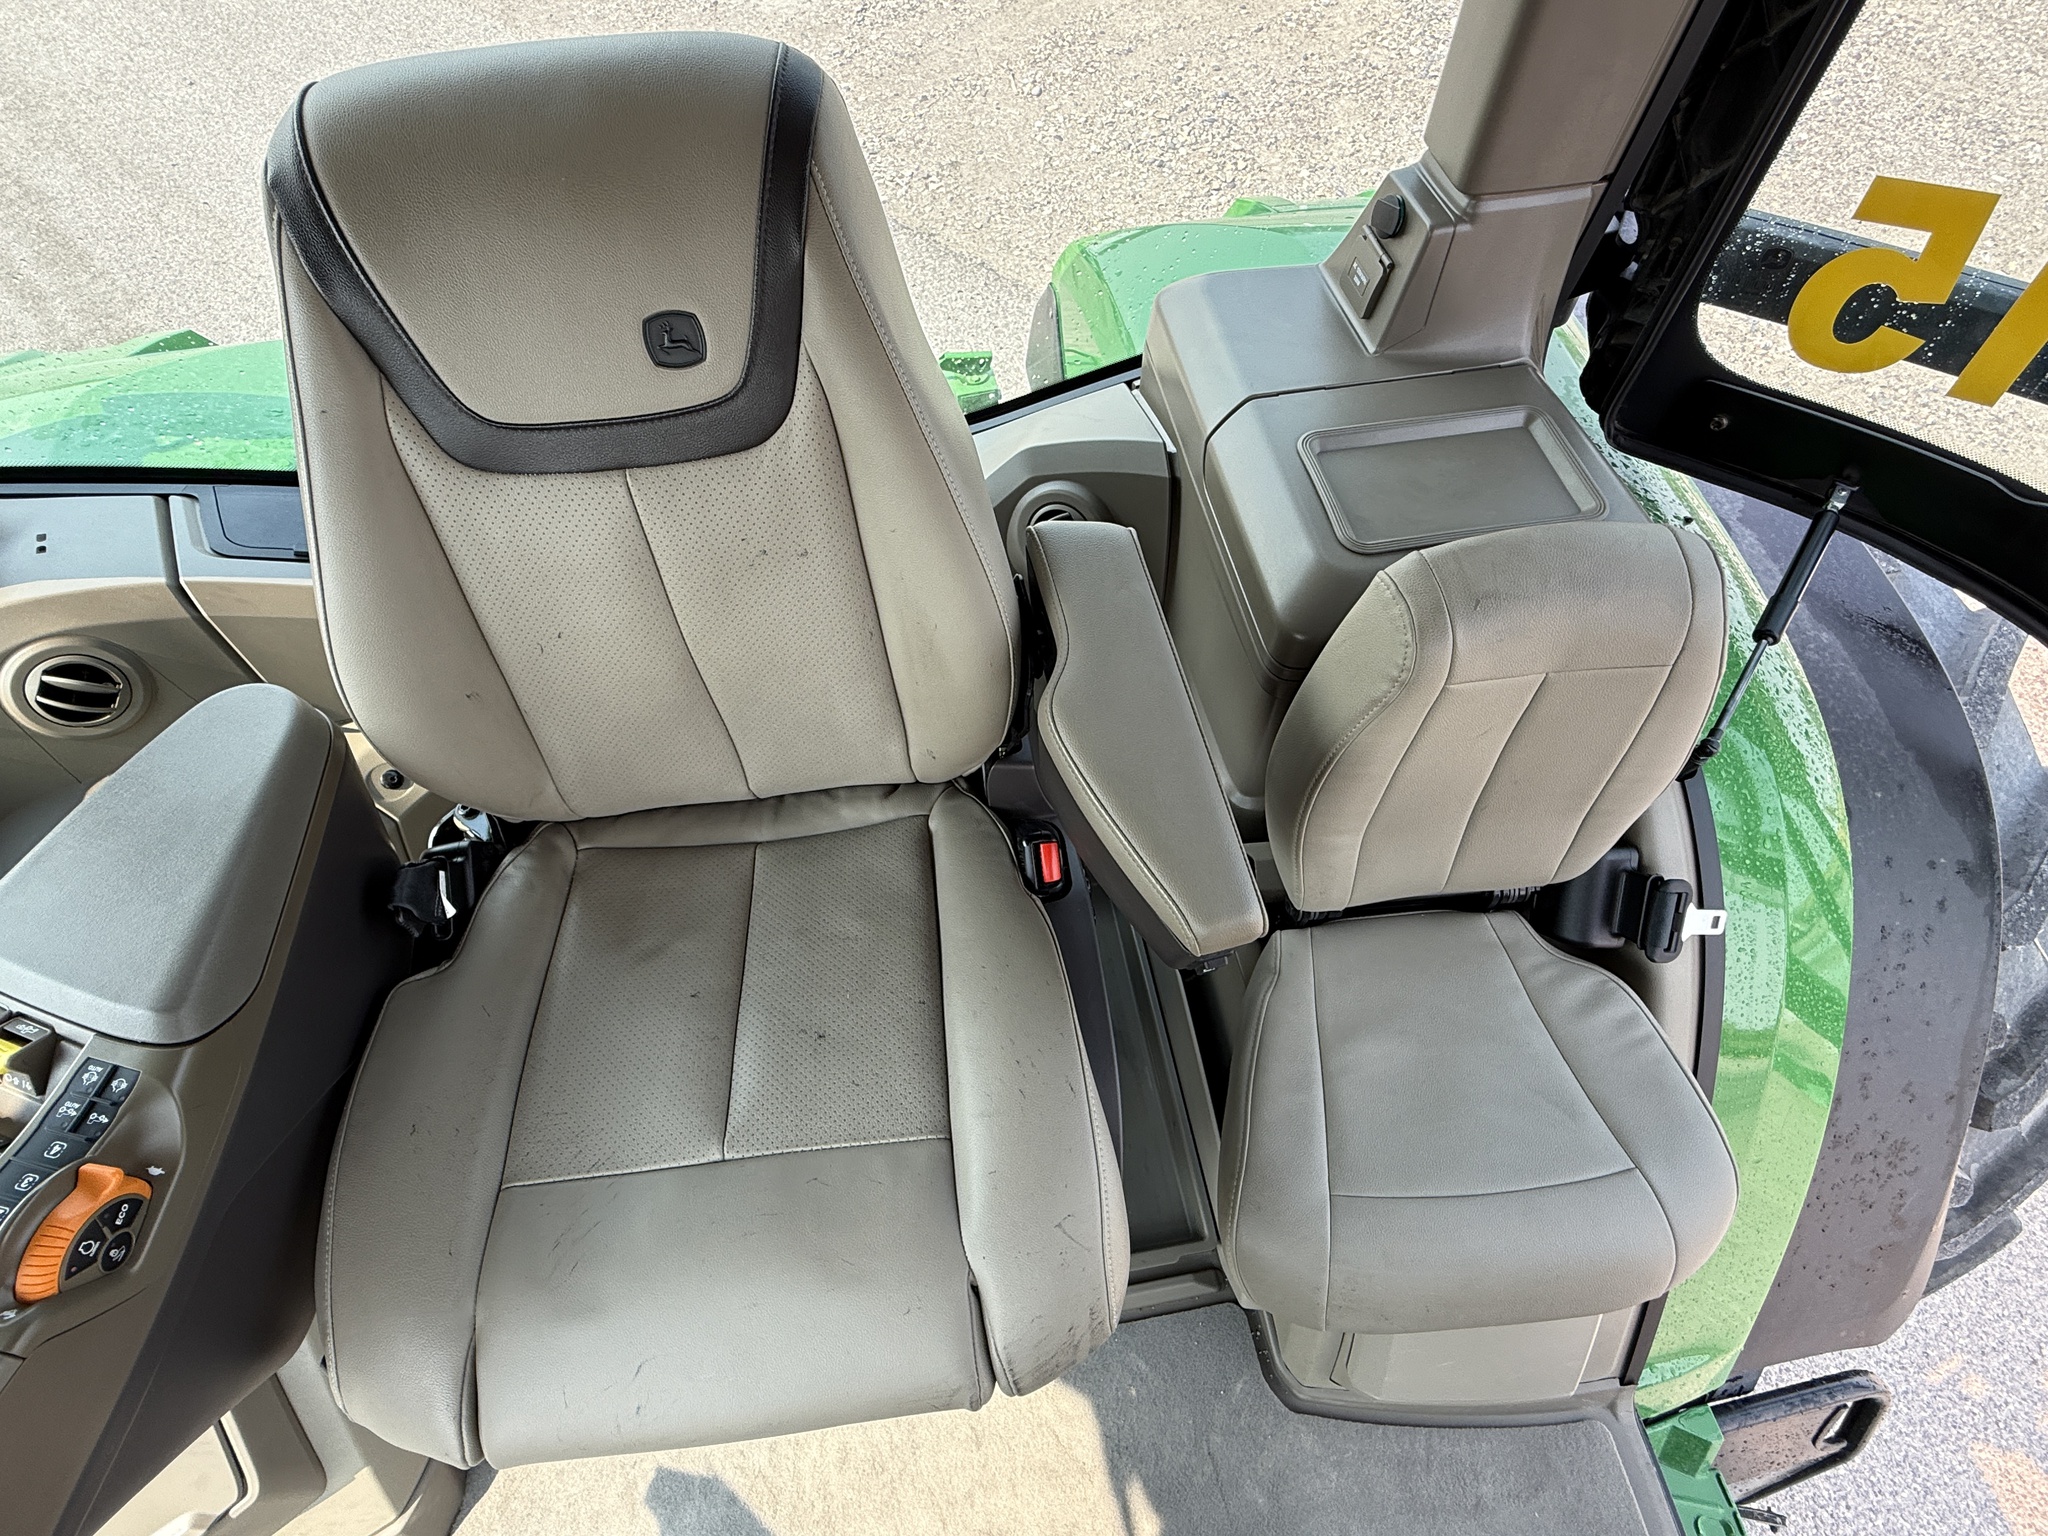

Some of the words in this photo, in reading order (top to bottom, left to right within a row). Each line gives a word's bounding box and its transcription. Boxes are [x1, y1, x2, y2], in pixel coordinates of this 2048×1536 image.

[88, 1064, 103, 1072] AUTO
[65, 1101, 80, 1109] AUTO
[115, 1204, 129, 1225] ECO
